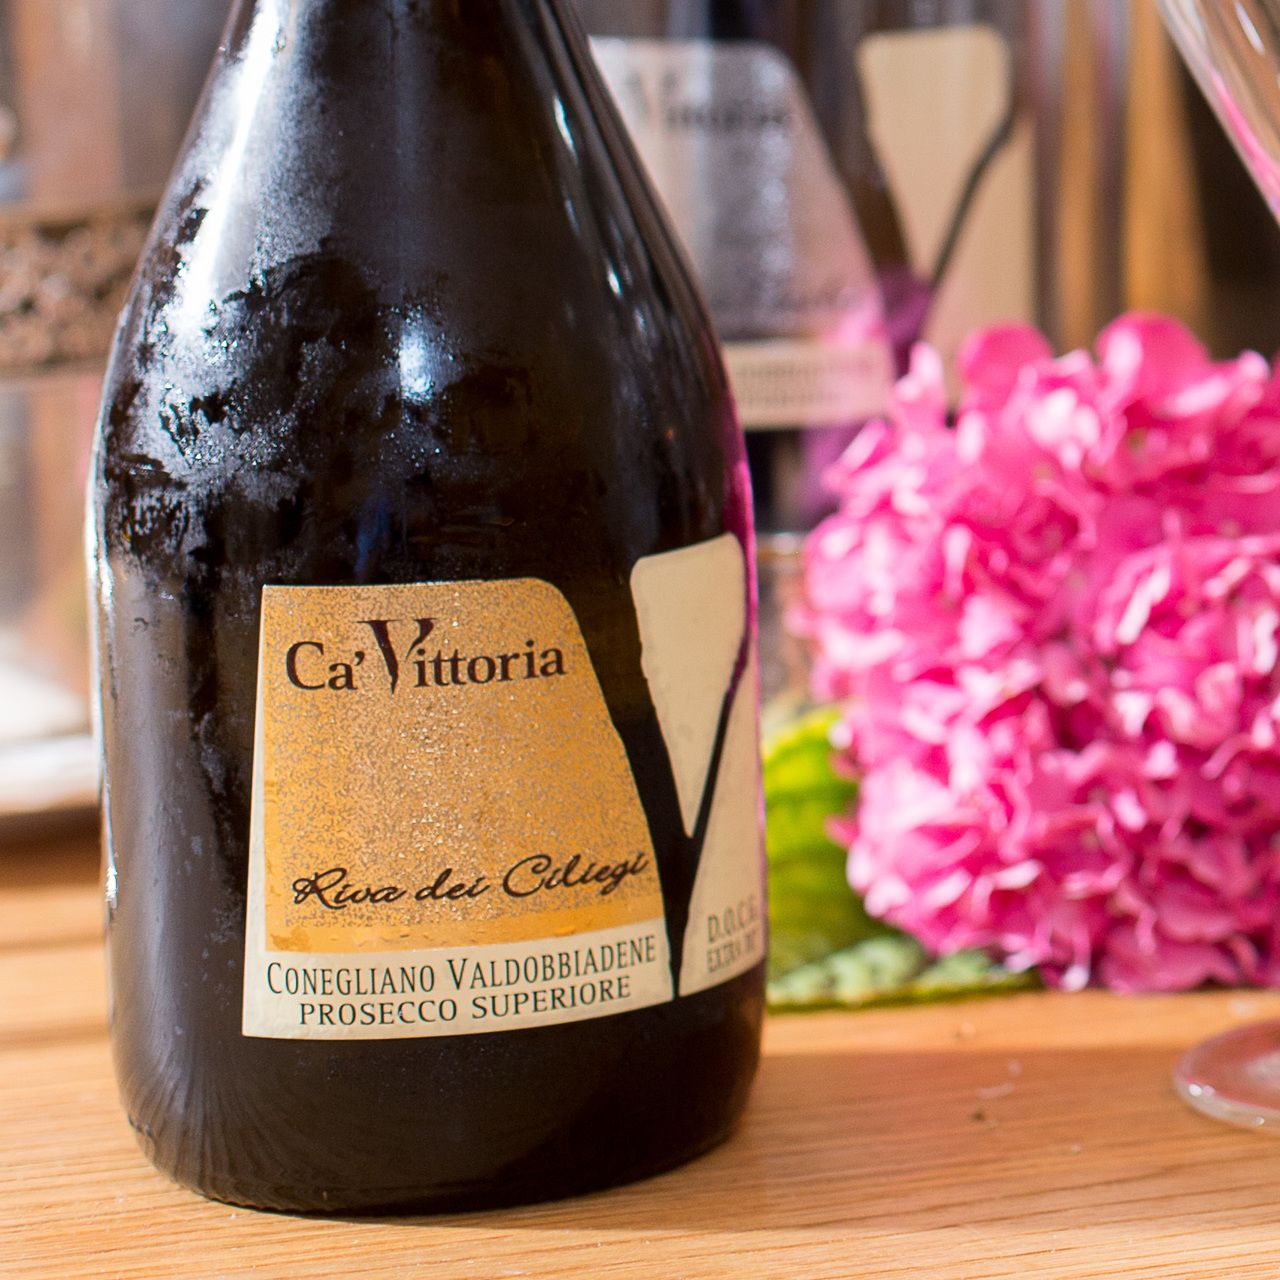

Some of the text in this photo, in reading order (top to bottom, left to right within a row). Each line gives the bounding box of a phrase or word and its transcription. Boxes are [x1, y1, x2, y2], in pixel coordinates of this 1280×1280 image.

[285, 616, 568, 695] Ca' Vittoria
[291, 852, 649, 910] Riva dei Ciliegi
[266, 933, 657, 996] CONEGLIANO VALDOBBIADENE
[298, 975, 632, 1026] PROSECCO SUPERIORE
